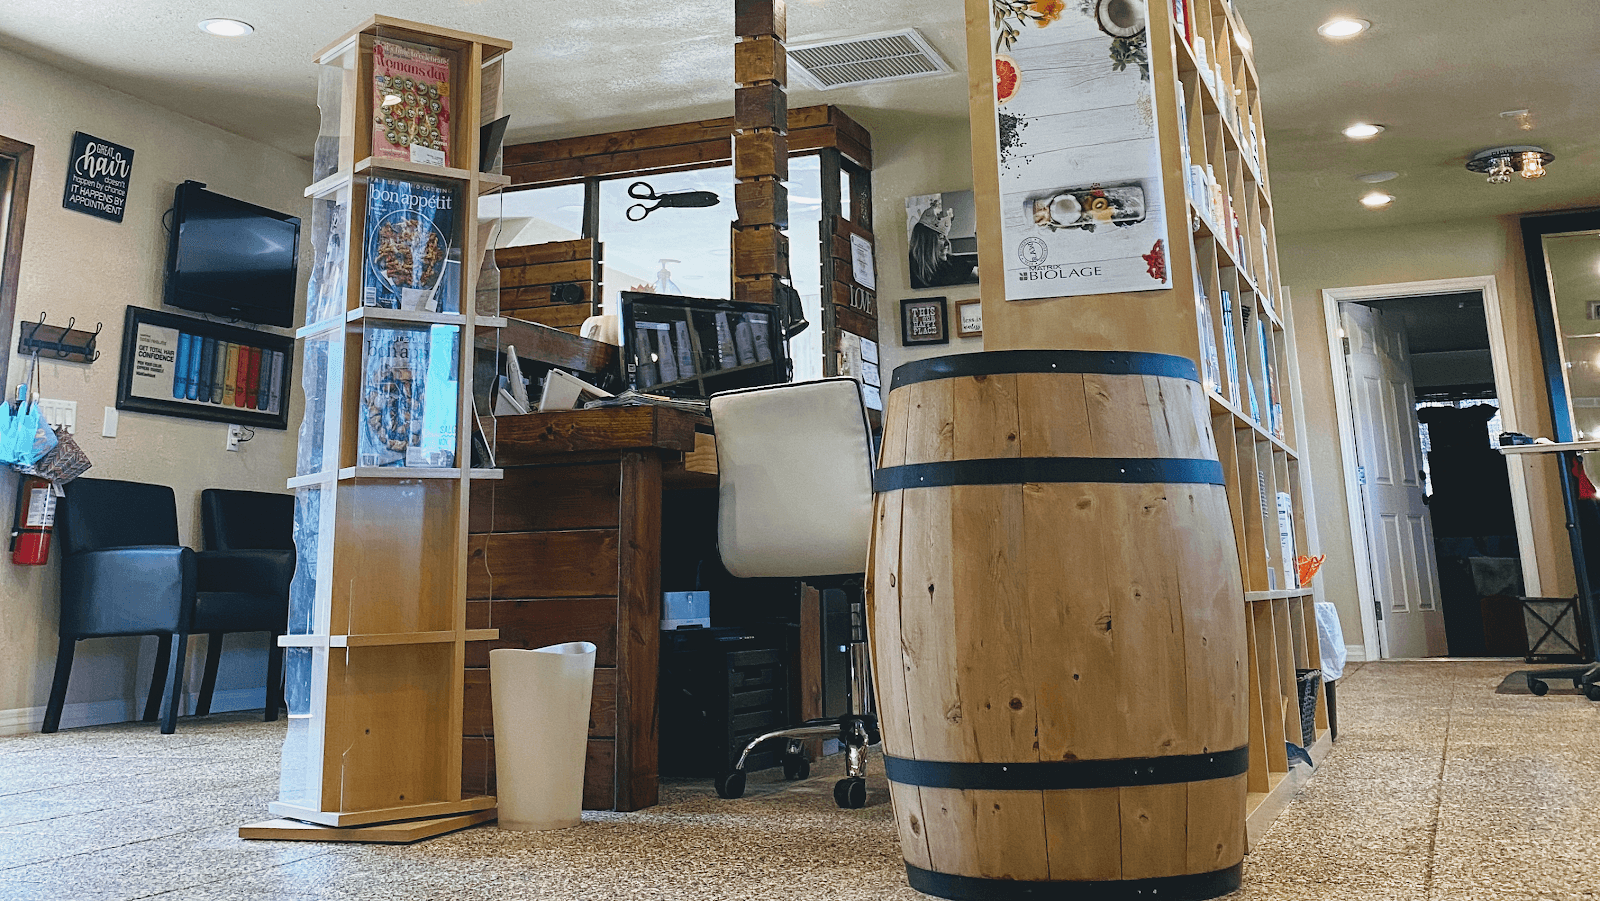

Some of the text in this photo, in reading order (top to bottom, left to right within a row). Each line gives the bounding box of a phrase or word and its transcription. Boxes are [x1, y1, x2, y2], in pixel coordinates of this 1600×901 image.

[96, 143, 114, 157] GREAT
[75, 141, 130, 178] hair
[73, 174, 126, 196] happen by chance
[104, 176, 125, 188] doesn't
[71, 184, 125, 206] IT HAPPENS BY
[370, 183, 400, 203] bon
[401, 193, 452, 211] appétit
[69, 194, 122, 215] APPOINTMENT
[1029, 266, 1102, 281] BIOLAGE
[849, 283, 873, 315] LOVE
[912, 306, 936, 317] THIS
[913, 320, 936, 328] HAPPY
[913, 326, 937, 336] PLACE
[138, 351, 174, 362] CONFIDENCE
